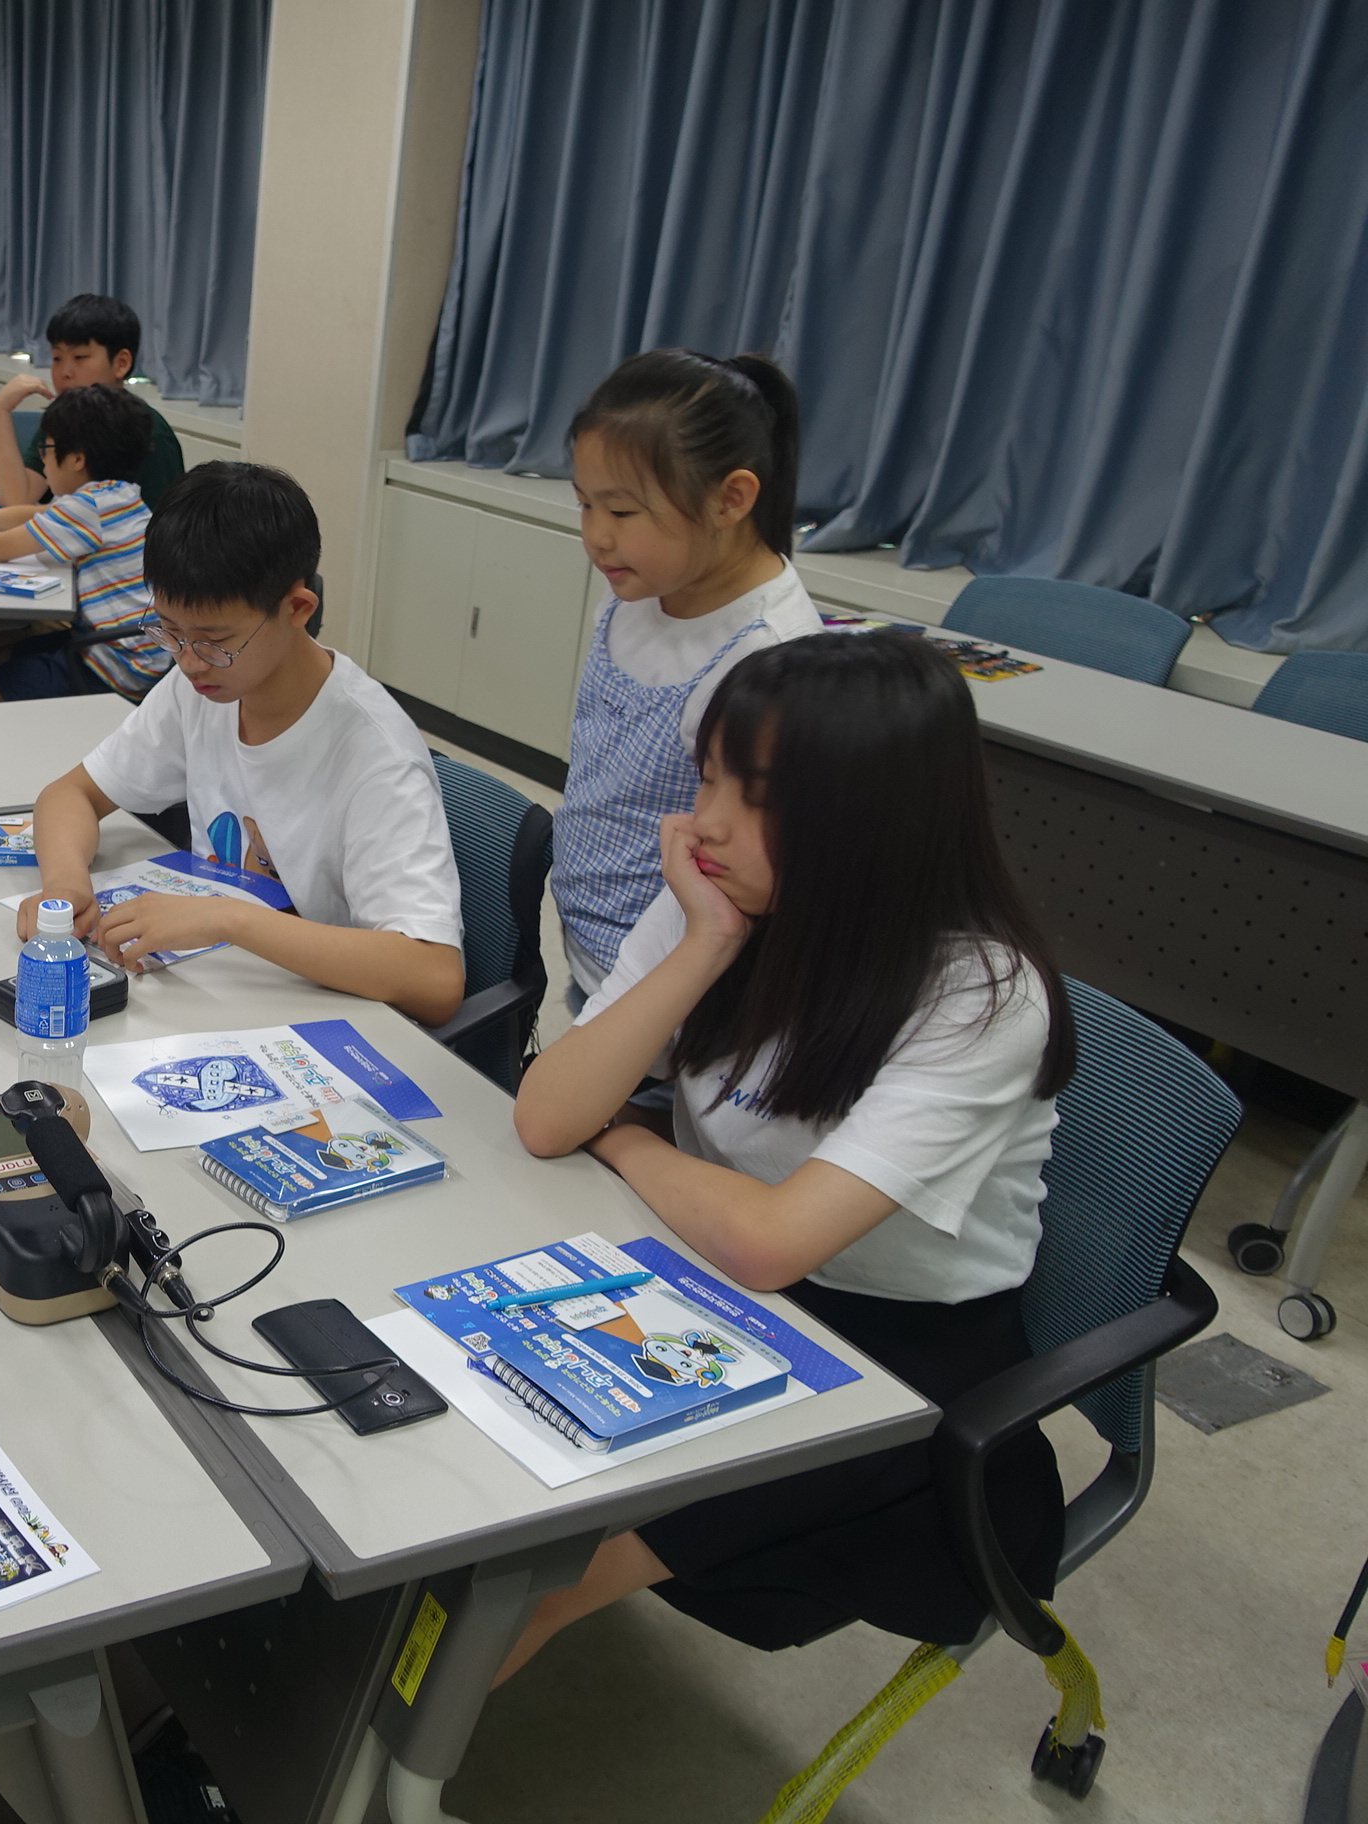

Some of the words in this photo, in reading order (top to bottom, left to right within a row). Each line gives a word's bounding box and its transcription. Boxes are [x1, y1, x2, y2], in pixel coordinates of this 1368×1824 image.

[239, 1135, 297, 1174] 주니어닥터
[532, 1333, 610, 1388] 주니어닥터
[609, 1387, 642, 1412] 제11회
